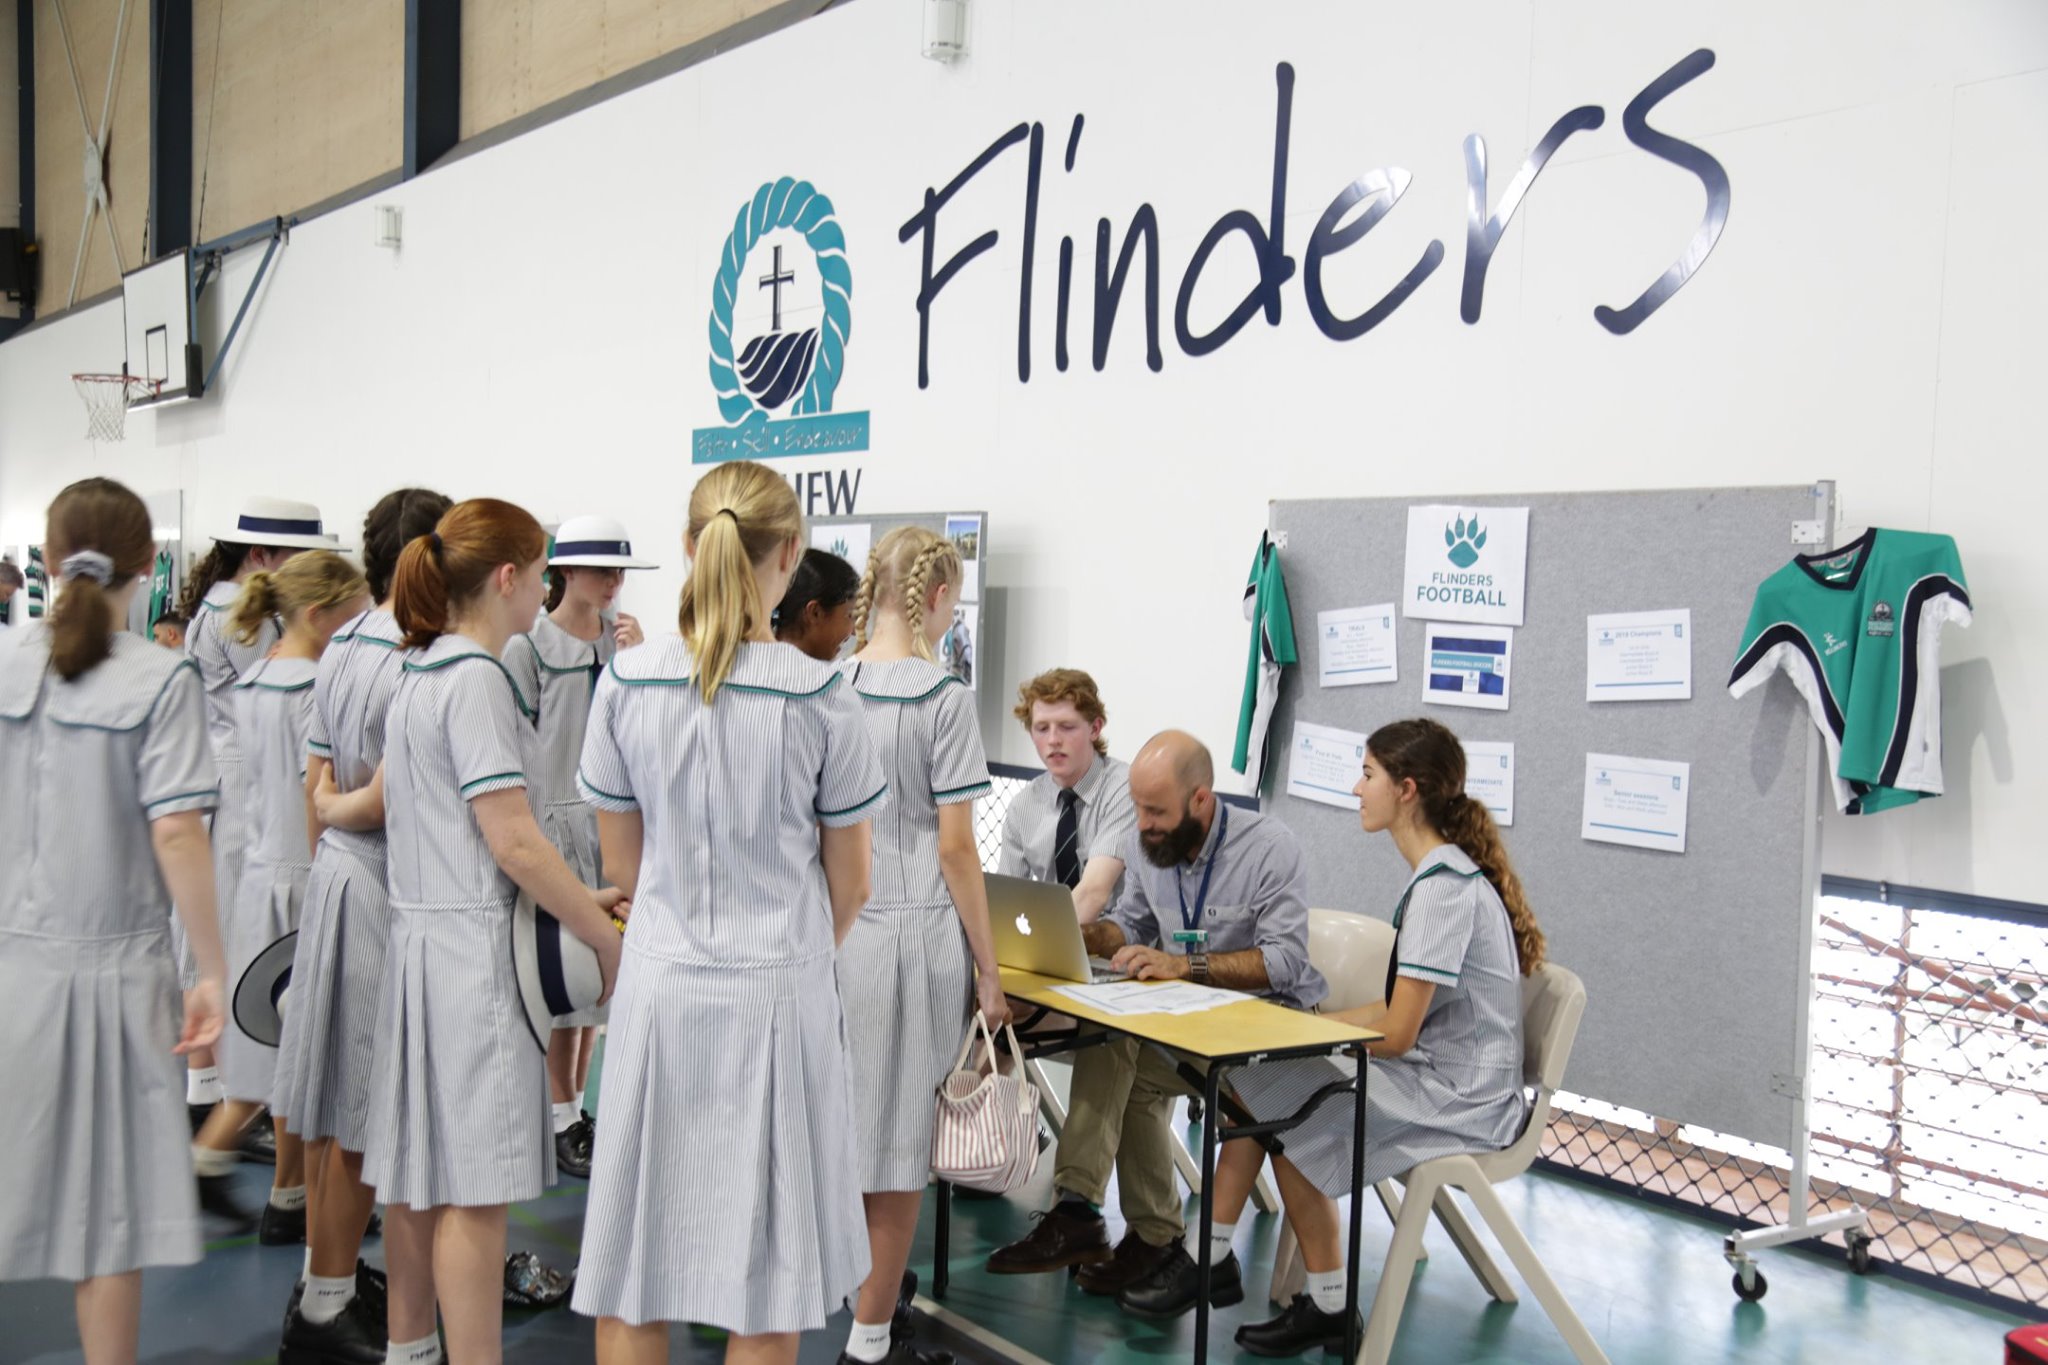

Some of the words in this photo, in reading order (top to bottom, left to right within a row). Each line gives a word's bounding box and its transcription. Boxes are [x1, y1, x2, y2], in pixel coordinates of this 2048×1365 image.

[899, 48, 1731, 390] Flinders
[1432, 572, 1494, 587] FLINDERS
[1416, 586, 1507, 608] FOOTBALL
